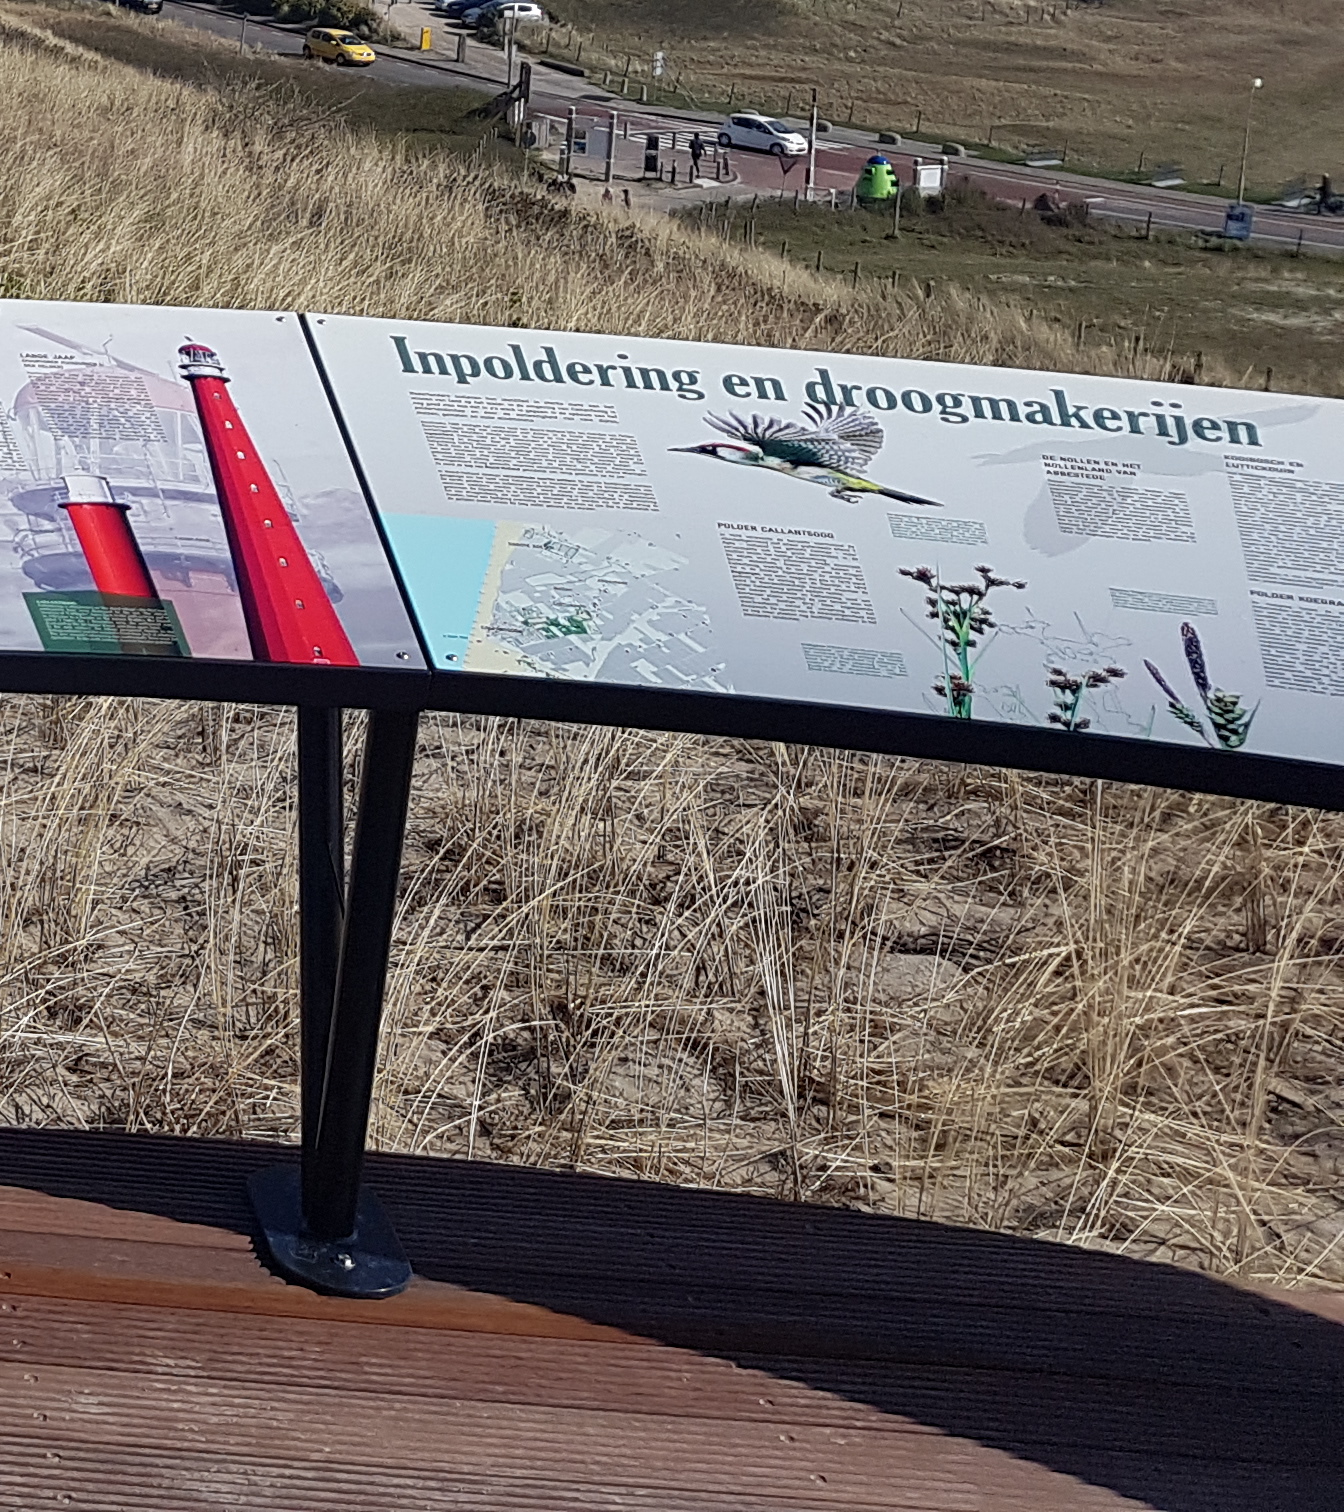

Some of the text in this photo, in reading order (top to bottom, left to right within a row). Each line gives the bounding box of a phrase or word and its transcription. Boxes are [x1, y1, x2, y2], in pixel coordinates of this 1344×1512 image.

[389, 334, 1262, 447] Inpoldering en droogmakerijen
[717, 522, 757, 532] POLDER
